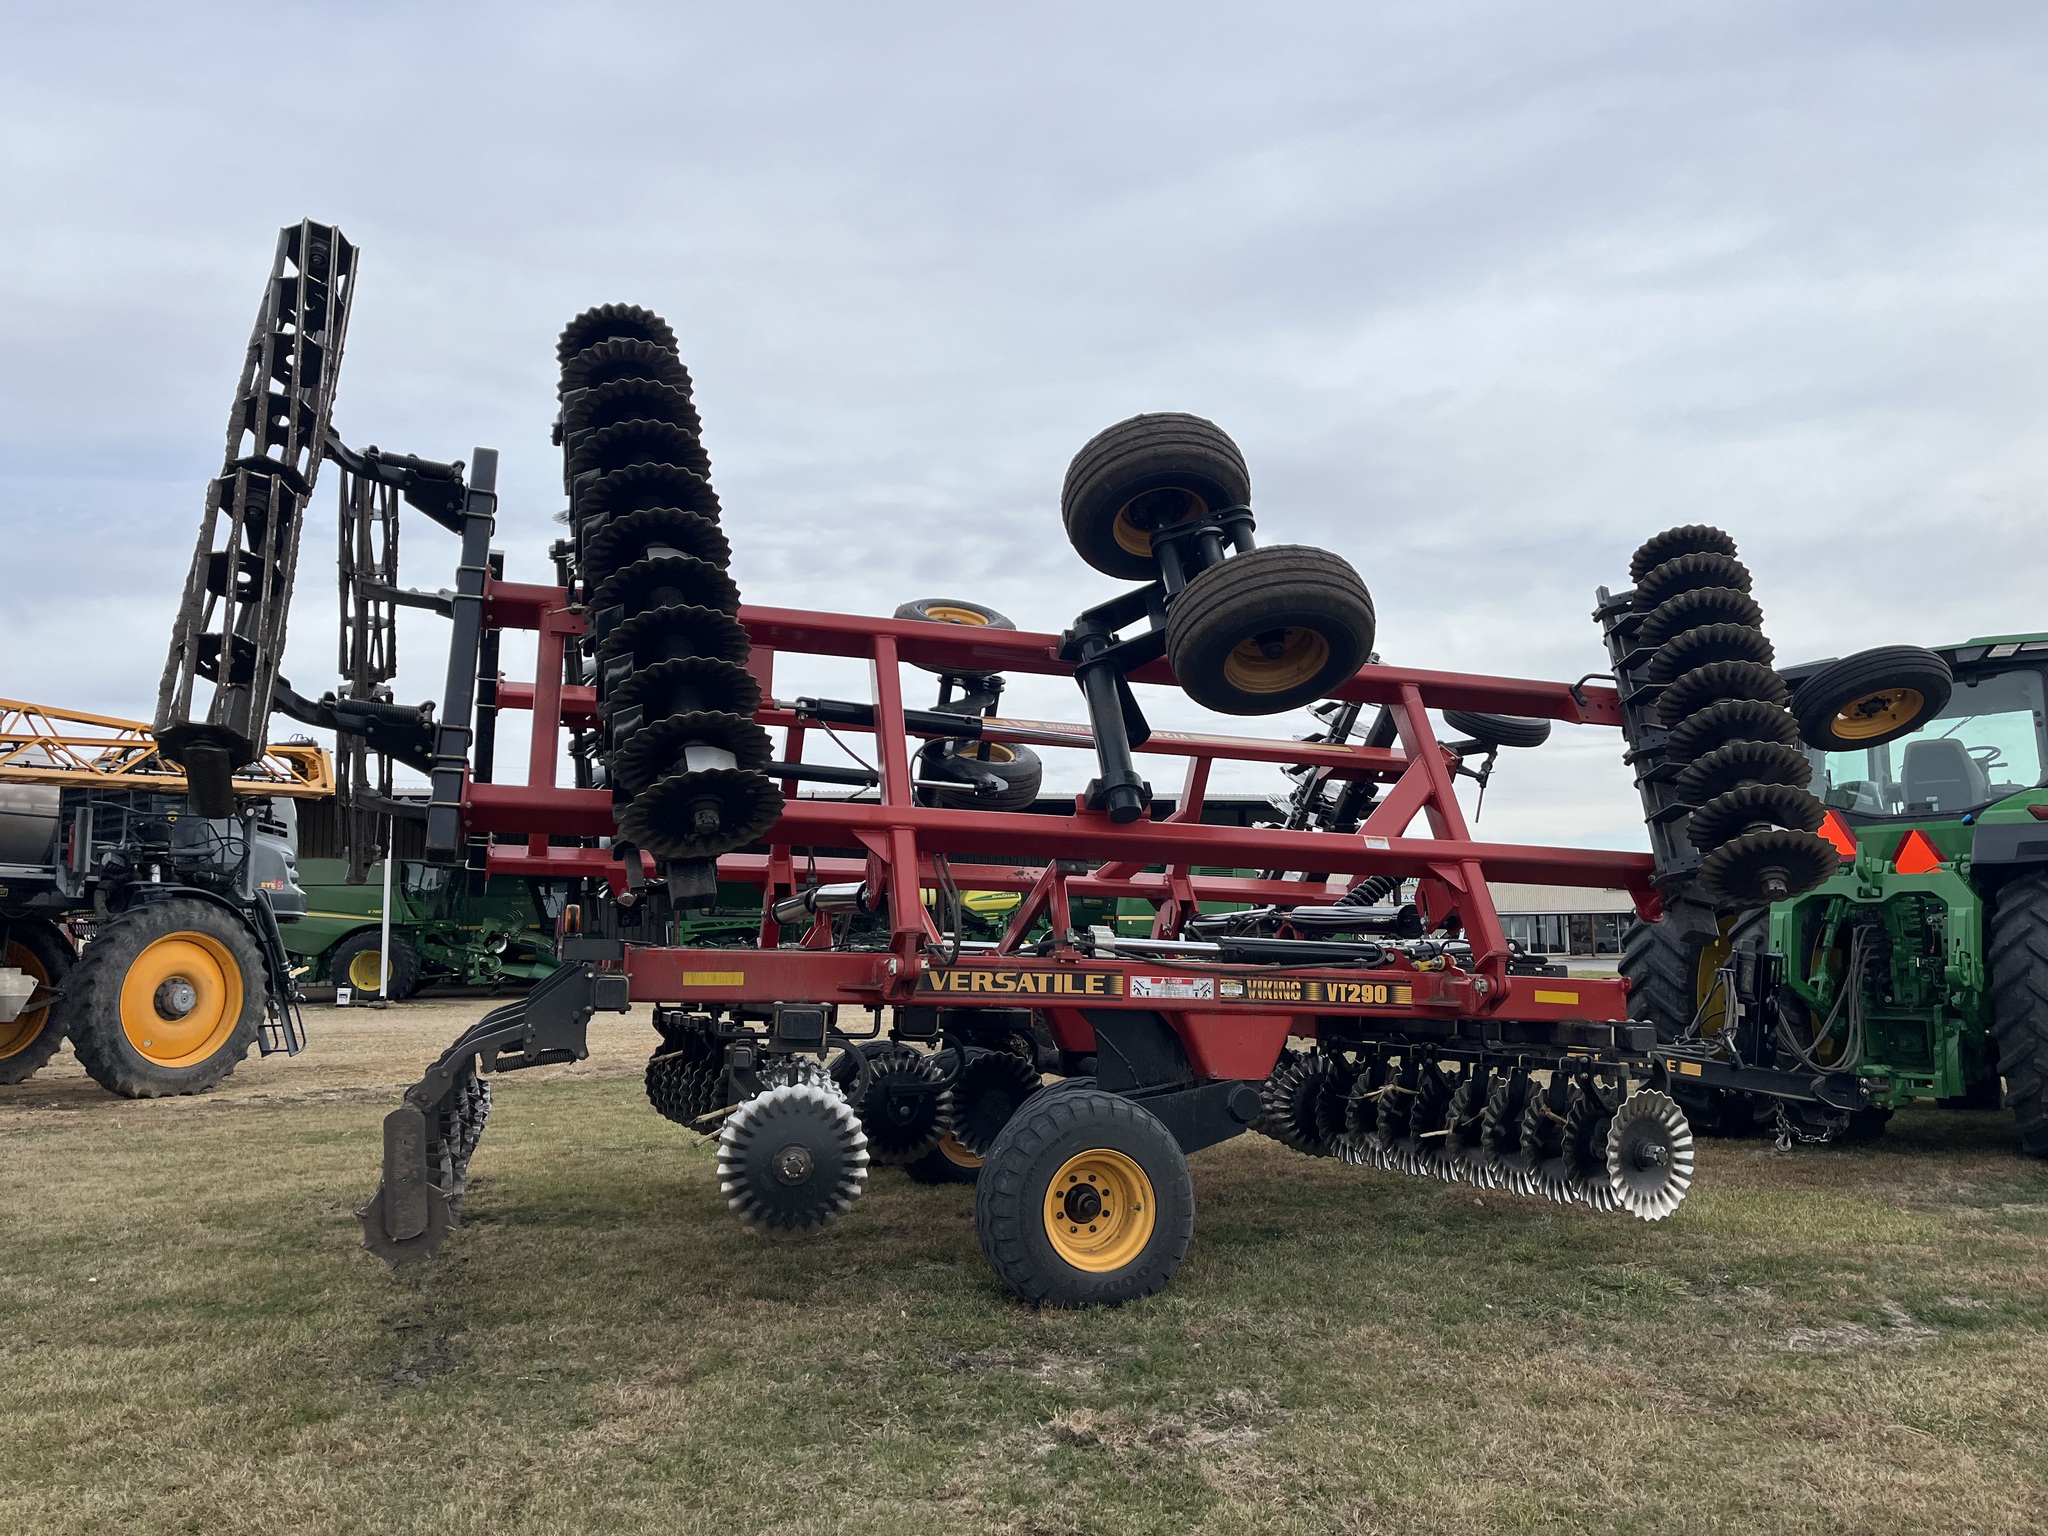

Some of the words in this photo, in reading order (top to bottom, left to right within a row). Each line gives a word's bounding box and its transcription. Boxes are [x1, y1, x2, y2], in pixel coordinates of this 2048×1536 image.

[929, 971, 1106, 994] VERSATILE
[1246, 980, 1301, 1001] VIKING
[1327, 983, 1387, 1004] VT290
